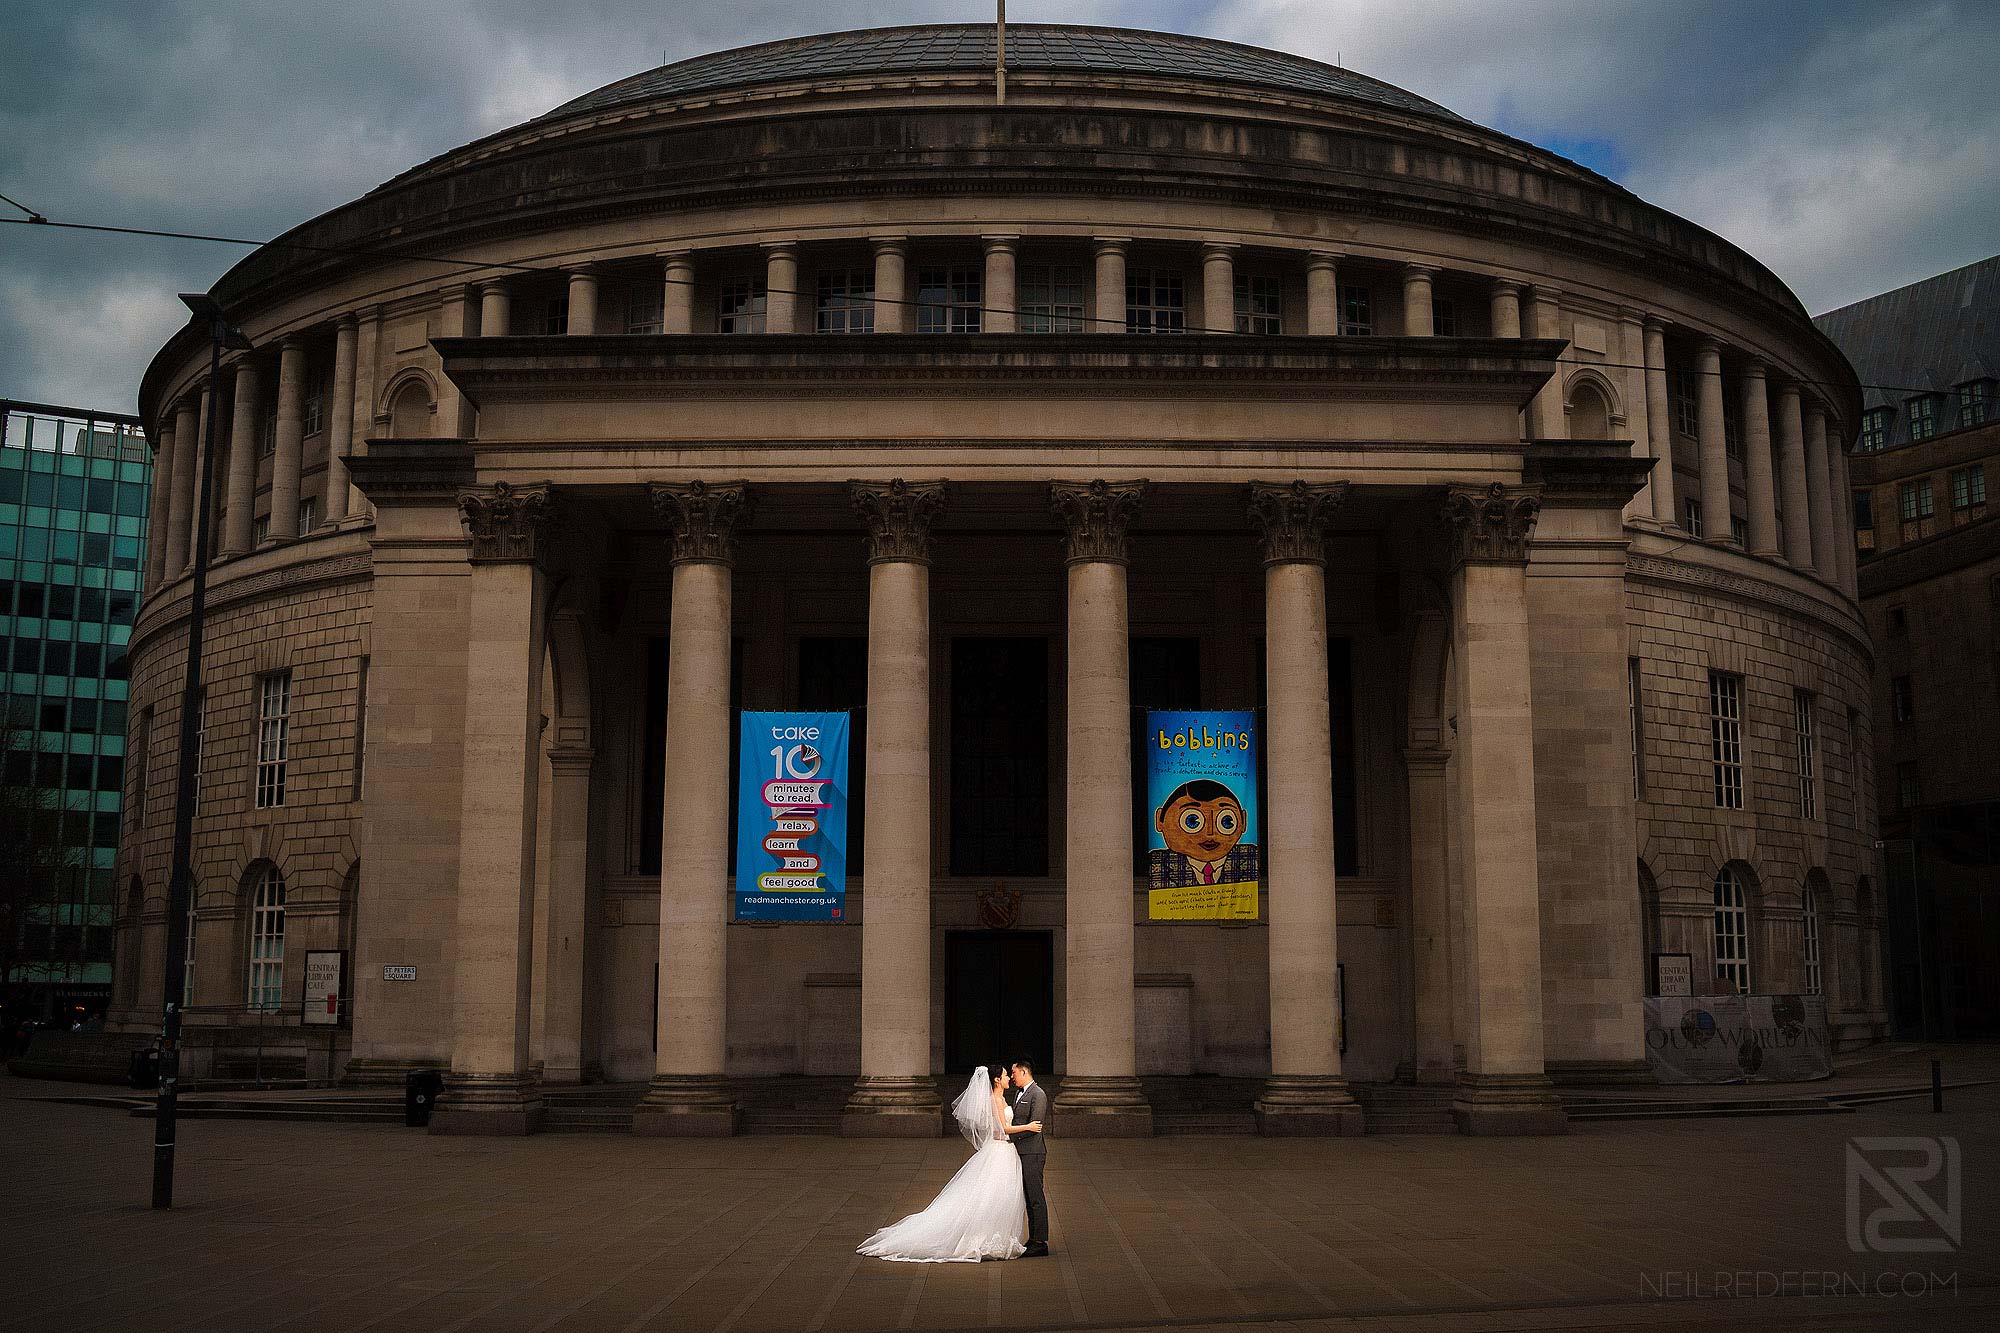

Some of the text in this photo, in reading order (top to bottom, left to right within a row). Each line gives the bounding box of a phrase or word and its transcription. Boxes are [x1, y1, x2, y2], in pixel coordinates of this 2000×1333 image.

[772, 726, 819, 740] take
[1158, 725, 1250, 751] bobbins
[770, 743, 821, 780] 10
[773, 784, 815, 793] minutes
[773, 793, 814, 804] to read,
[782, 821, 811, 831] relax,
[769, 839, 795, 849] learn
[789, 859, 810, 868] and
[765, 877, 815, 889] feel good
[744, 896, 837, 906] readmanchester.org.uk
[1660, 966, 1688, 975] CENTRAL
[308, 973, 335, 981] LIBRARY
[388, 973, 411, 981] SQUARE
[1660, 975, 1685, 984] LIBRARY
